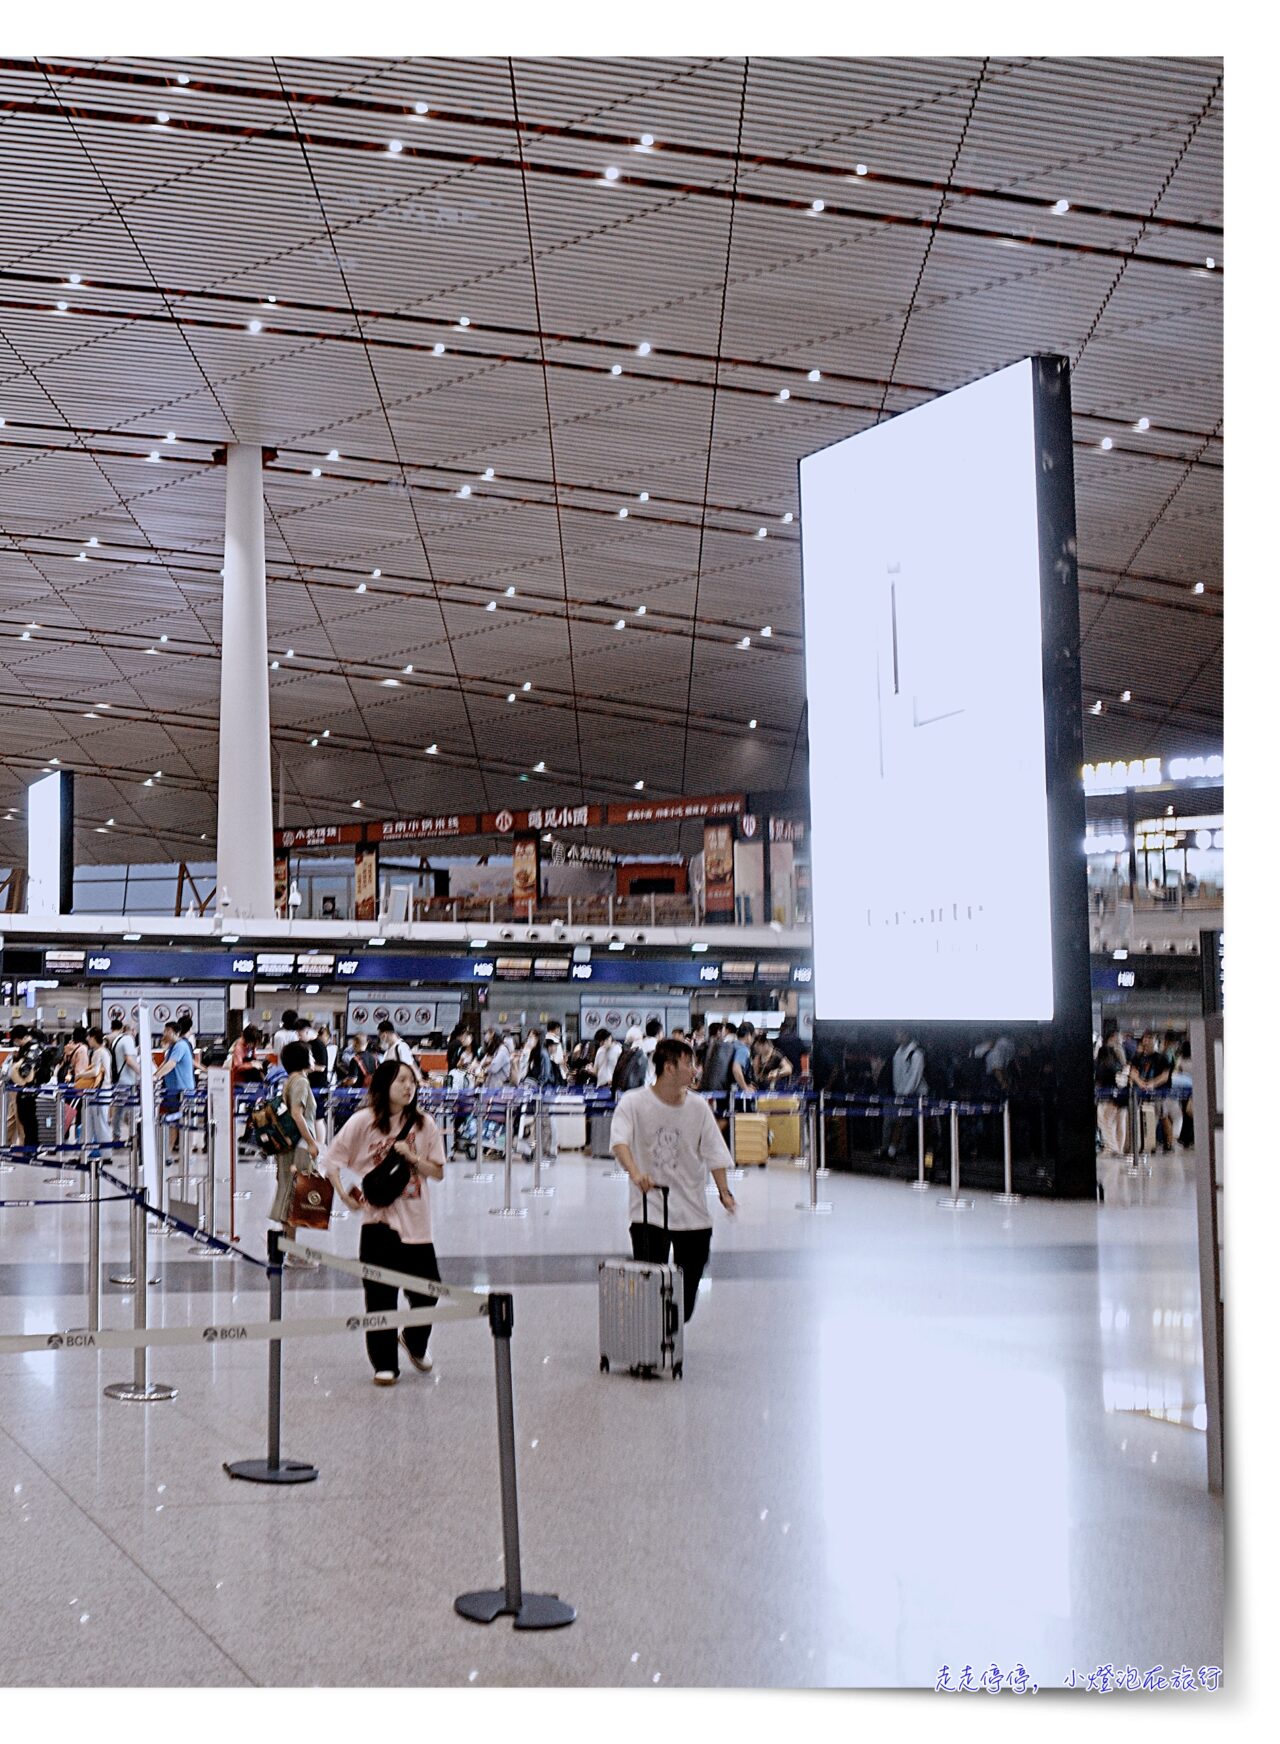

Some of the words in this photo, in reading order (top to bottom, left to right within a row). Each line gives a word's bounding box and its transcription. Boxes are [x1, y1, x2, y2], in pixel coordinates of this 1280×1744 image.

[362, 1316, 387, 1328] BCIA
[219, 1327, 247, 1340] BCIA
[66, 1334, 95, 1347] BCIA
